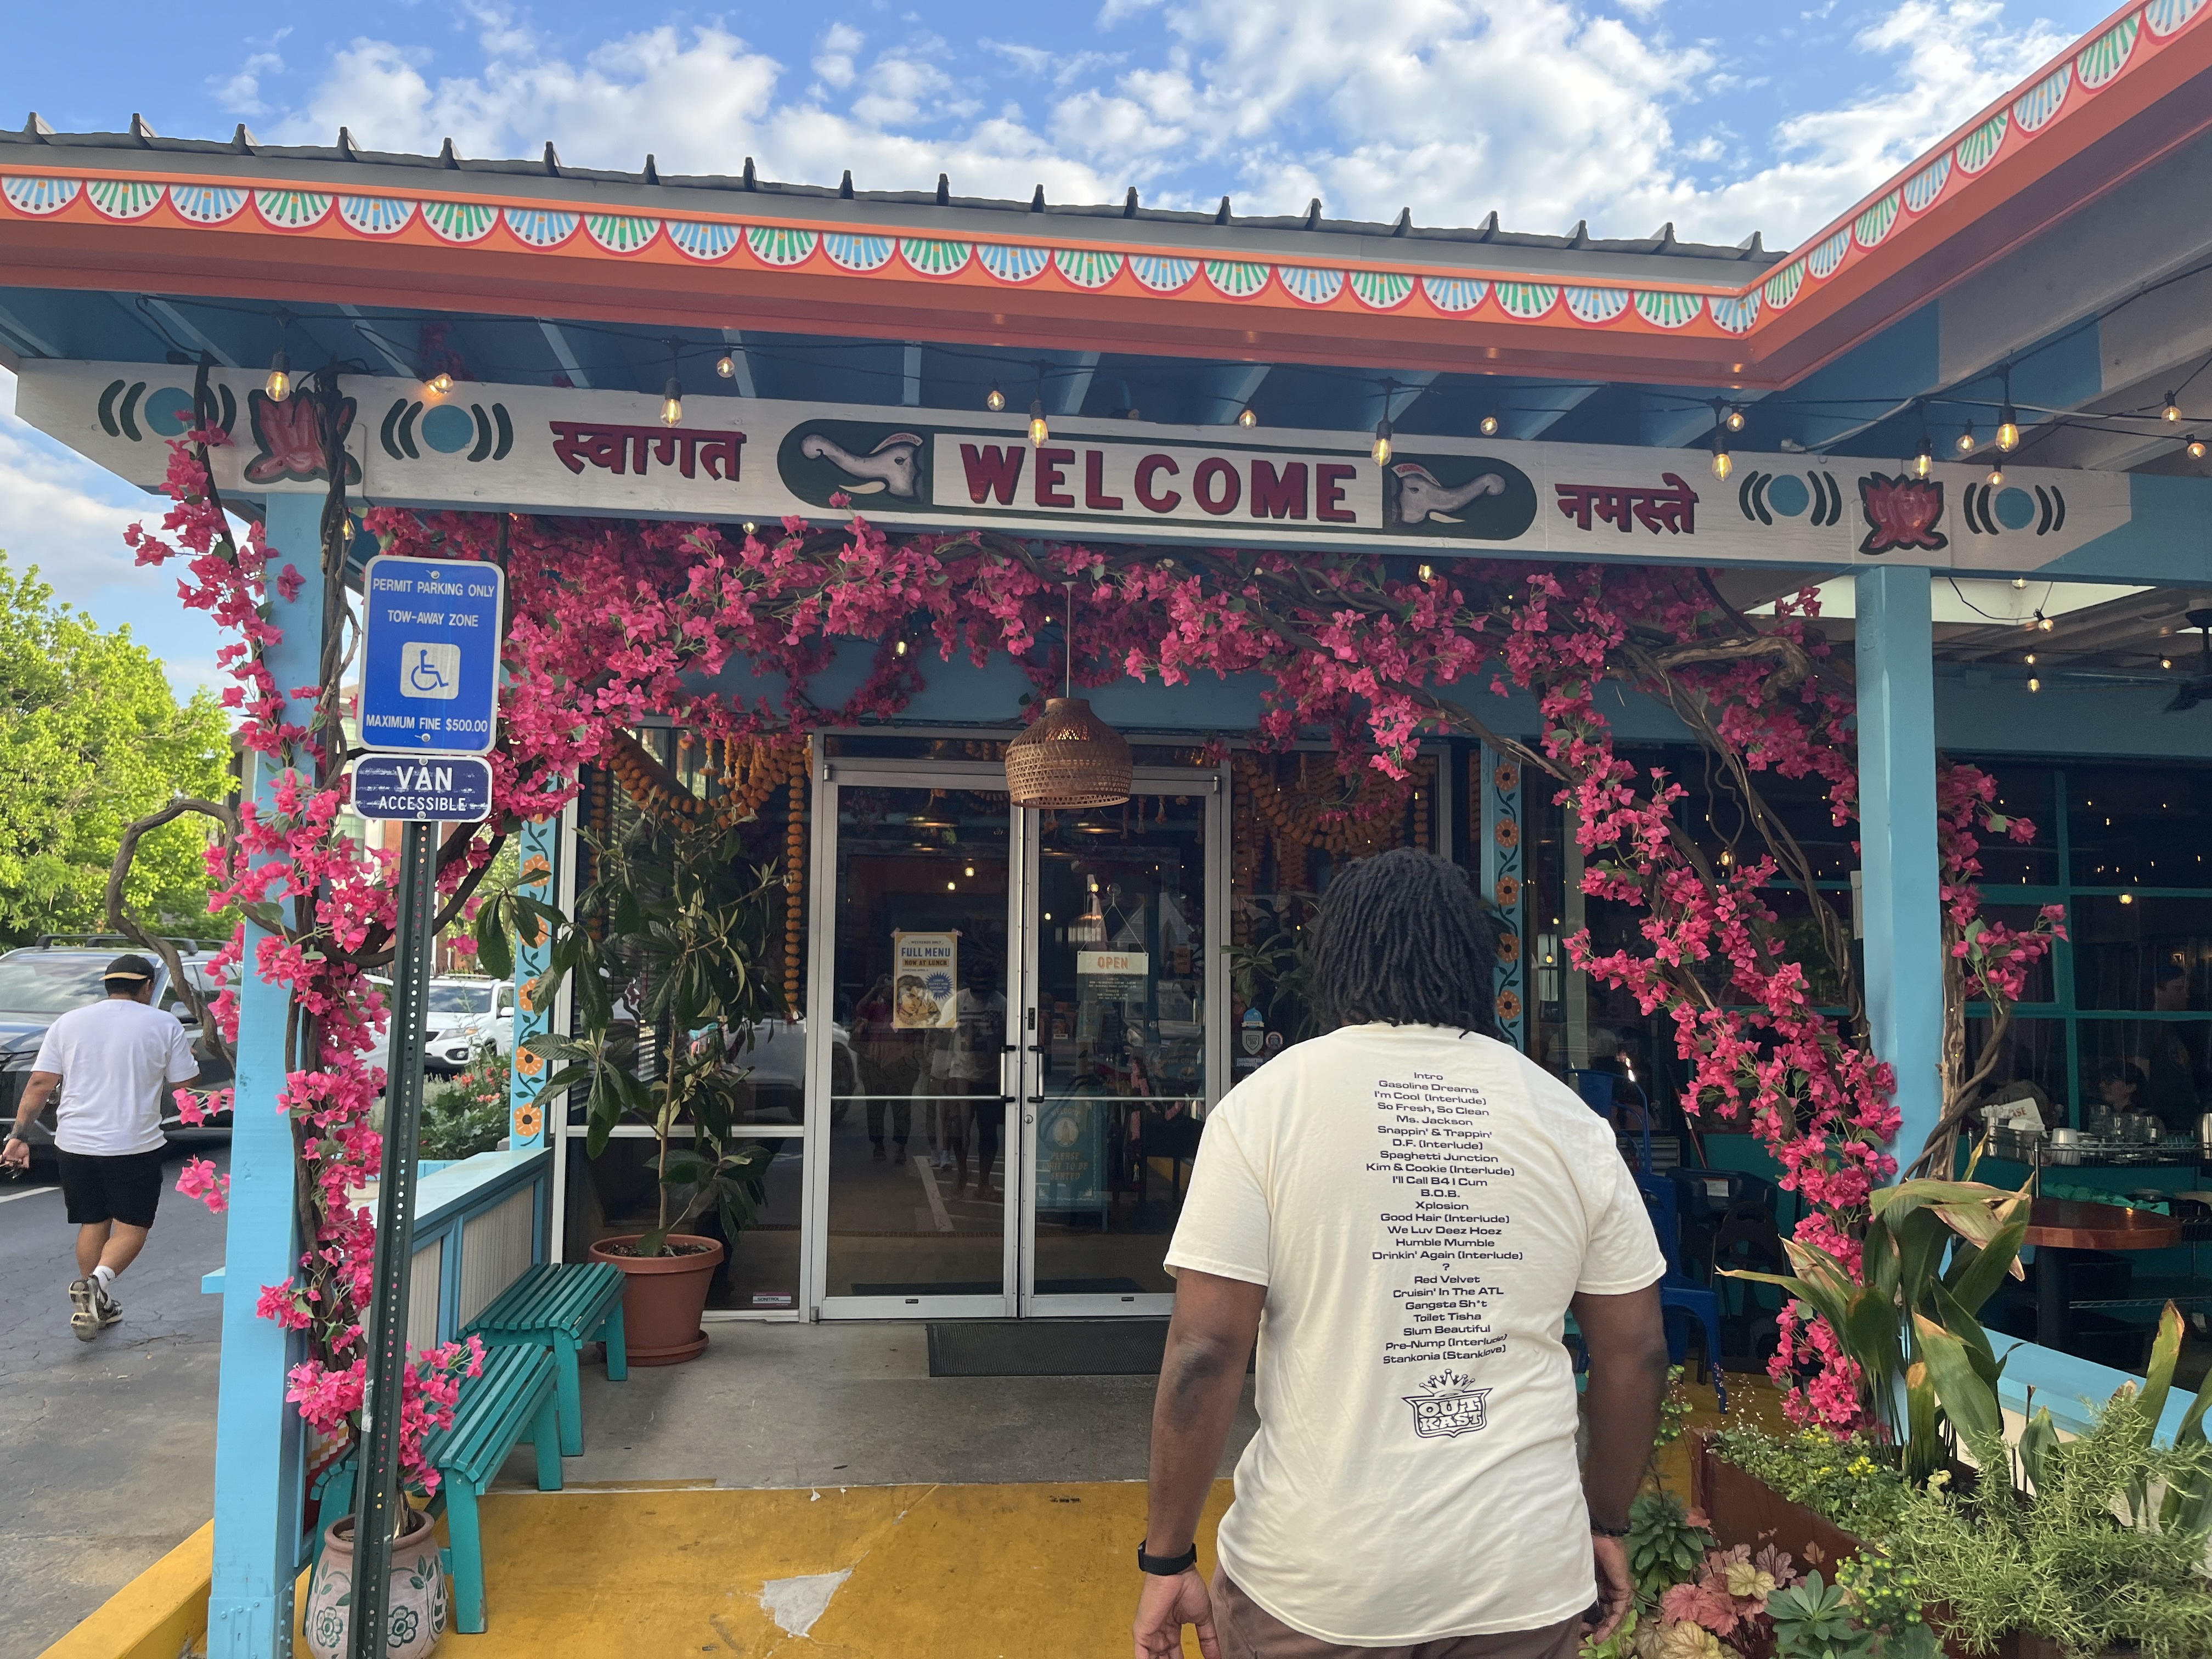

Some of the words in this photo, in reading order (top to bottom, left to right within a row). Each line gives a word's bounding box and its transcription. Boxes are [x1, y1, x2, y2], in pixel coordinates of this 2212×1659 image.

[549, 421, 747, 482] स्वागत
[960, 443, 1356, 522] WELCOME
[1555, 472, 1699, 535] नमस्ते
[373, 578, 412, 592] PERMIT
[417, 581, 463, 595] PARKING
[468, 584, 494, 597] ONLY
[387, 610, 444, 625] TOW-AWAY
[449, 613, 478, 627] ZONE
[366, 714, 415, 729] MAXIMUM
[419, 717, 441, 730] FINE
[445, 718, 488, 732] $500.00
[396, 766, 452, 791] VAN
[378, 795, 466, 811] ACCESSIBLE
[901, 948, 922, 957] FULL
[925, 948, 950, 957] MENU
[1098, 956, 1129, 969] OPEN
[1379, 1080, 1428, 1090] Gasoline
[1431, 1084, 1479, 1093] Dreams
[1425, 1094, 1486, 1105] (Interlude)
[1396, 1104, 1434, 1114] Fresh,
[1455, 1107, 1489, 1115] Clean
[1422, 1117, 1472, 1125] Jackson
[1378, 1126, 1428, 1136] Snappin'
[1443, 1129, 1492, 1139] Trappin'
[1419, 1140, 1482, 1150] (Interlude)
[1380, 1151, 1440, 1161] Spaghetti
[1443, 1153, 1498, 1162] Junction
[1406, 1164, 1447, 1172] Cookie
[1450, 1165, 1514, 1176] (Interlude)
[1415, 1201, 1469, 1211] Xplosion
[1445, 1214, 1509, 1223] (Interlude)
[1372, 1251, 1417, 1260] Drinkin'
[1420, 1251, 1455, 1260] Again
[1458, 1251, 1522, 1260] (Interlude)
[1415, 1276, 1437, 1284] Red
[1393, 1288, 1436, 1297] Cruisin'
[1406, 1301, 1456, 1310] Gangsta
[1413, 1314, 1445, 1322] Toilet
[1403, 1328, 1431, 1336] Slum
[1435, 1325, 1490, 1334] Beautiful
[1386, 1340, 1445, 1351] Pre-Nump
[1448, 1334, 1508, 1346] (Interlude)
[1384, 1352, 1440, 1364] Stankonia
[1443, 1345, 1505, 1359] (Stanklove)
[1419, 1396, 1481, 1417] OUT
[1419, 1411, 1482, 1431] KAST
